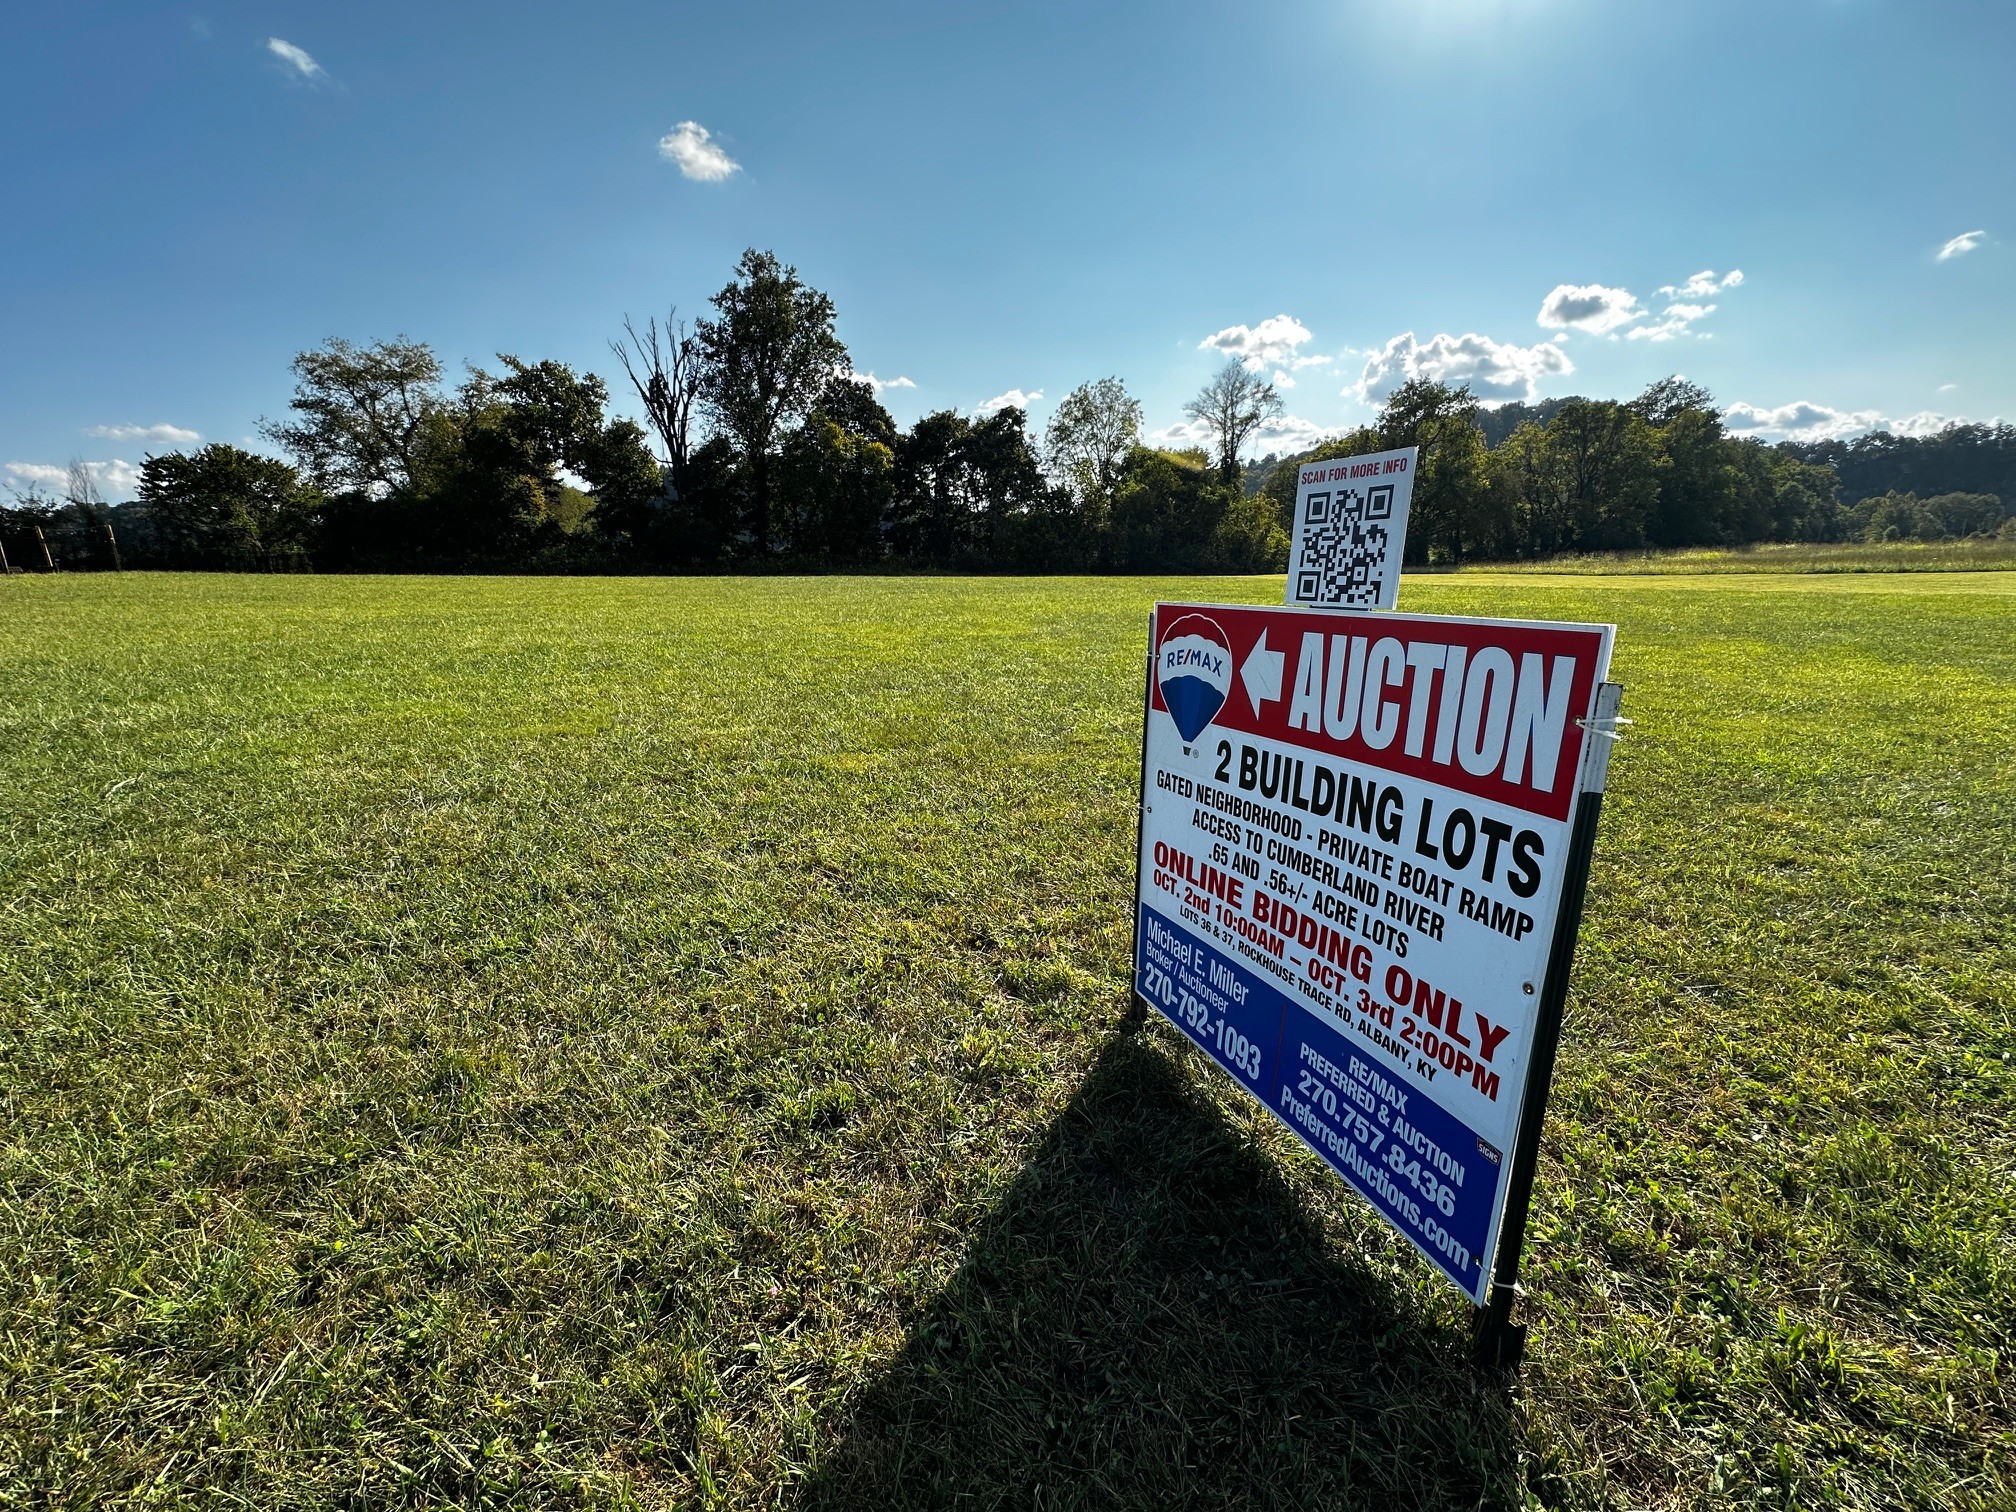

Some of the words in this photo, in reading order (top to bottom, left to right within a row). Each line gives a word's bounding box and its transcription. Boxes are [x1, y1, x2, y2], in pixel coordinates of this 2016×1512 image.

[1302, 470, 1326, 484] SCAN
[1328, 467, 1347, 481] FOR
[1350, 462, 1380, 479] MORE
[1382, 458, 1408, 474] INFO
[1167, 649, 1222, 678] RE/MAX
[1288, 632, 1577, 793] AUCTION
[1157, 769, 1192, 798] GATED
[1196, 784, 1302, 842] NEIGHBORHOOD
[1318, 828, 1394, 881] PRIVATE
[1398, 860, 1454, 907] BOAT
[1458, 886, 1534, 942] RAMP
[1192, 808, 1241, 845] ACCESS
[1246, 829, 1263, 854] TO
[1267, 838, 1379, 908] CUMBERLAND
[1384, 890, 1444, 942] RIVER
[1214, 740, 1232, 784] 2
[1238, 745, 1404, 846] BUILDING
[1416, 798, 1544, 898] LOTS
[1147, 916, 1192, 966] Michael
[1194, 948, 1206, 978] E.
[1209, 958, 1250, 1006] Miller
[1154, 840, 1244, 910] ONLINE
[1252, 890, 1372, 984] BIDDING
[1385, 964, 1510, 1064] ONLY
[1208, 842, 1229, 866] .65
[1232, 852, 1260, 880] AND
[1264, 868, 1308, 904] .56+/-
[1312, 890, 1358, 932] ACRE
[1362, 913, 1409, 958] LOTS
[1144, 962, 1262, 1080] 270-792-1093
[1146, 940, 1174, 972] Broker
[1178, 965, 1229, 1014] Auctioneer
[1154, 868, 1180, 898] OCT.
[1184, 886, 1210, 916] 2nd
[1216, 904, 1285, 960] 10:00AM
[1308, 958, 1349, 1002] OCT.
[1356, 988, 1394, 1030] 3rd
[1400, 1016, 1500, 1102] 2:00PM
[1180, 904, 1199, 928] LOTS
[1200, 918, 1212, 932] 36
[1213, 926, 1220, 938] &
[1222, 930, 1236, 950] 37,
[1238, 940, 1296, 986] ROCKHOUSE
[1298, 978, 1332, 1012] TRACE
[1334, 1002, 1354, 1030] RD,
[1358, 1019, 1412, 1070] ALBANY,
[1416, 1058, 1438, 1082] KY
[1298, 1070, 1456, 1218] 270.757.8436
[1300, 1042, 1375, 1114] PREFERRED
[1378, 1105, 1390, 1127] &
[1392, 1116, 1466, 1188] AUCTION
[1348, 1056, 1409, 1116] RE/MAX
[1478, 1144, 1498, 1162] SIGNS
[1280, 1085, 1470, 1272] PreferredAuctions.com
